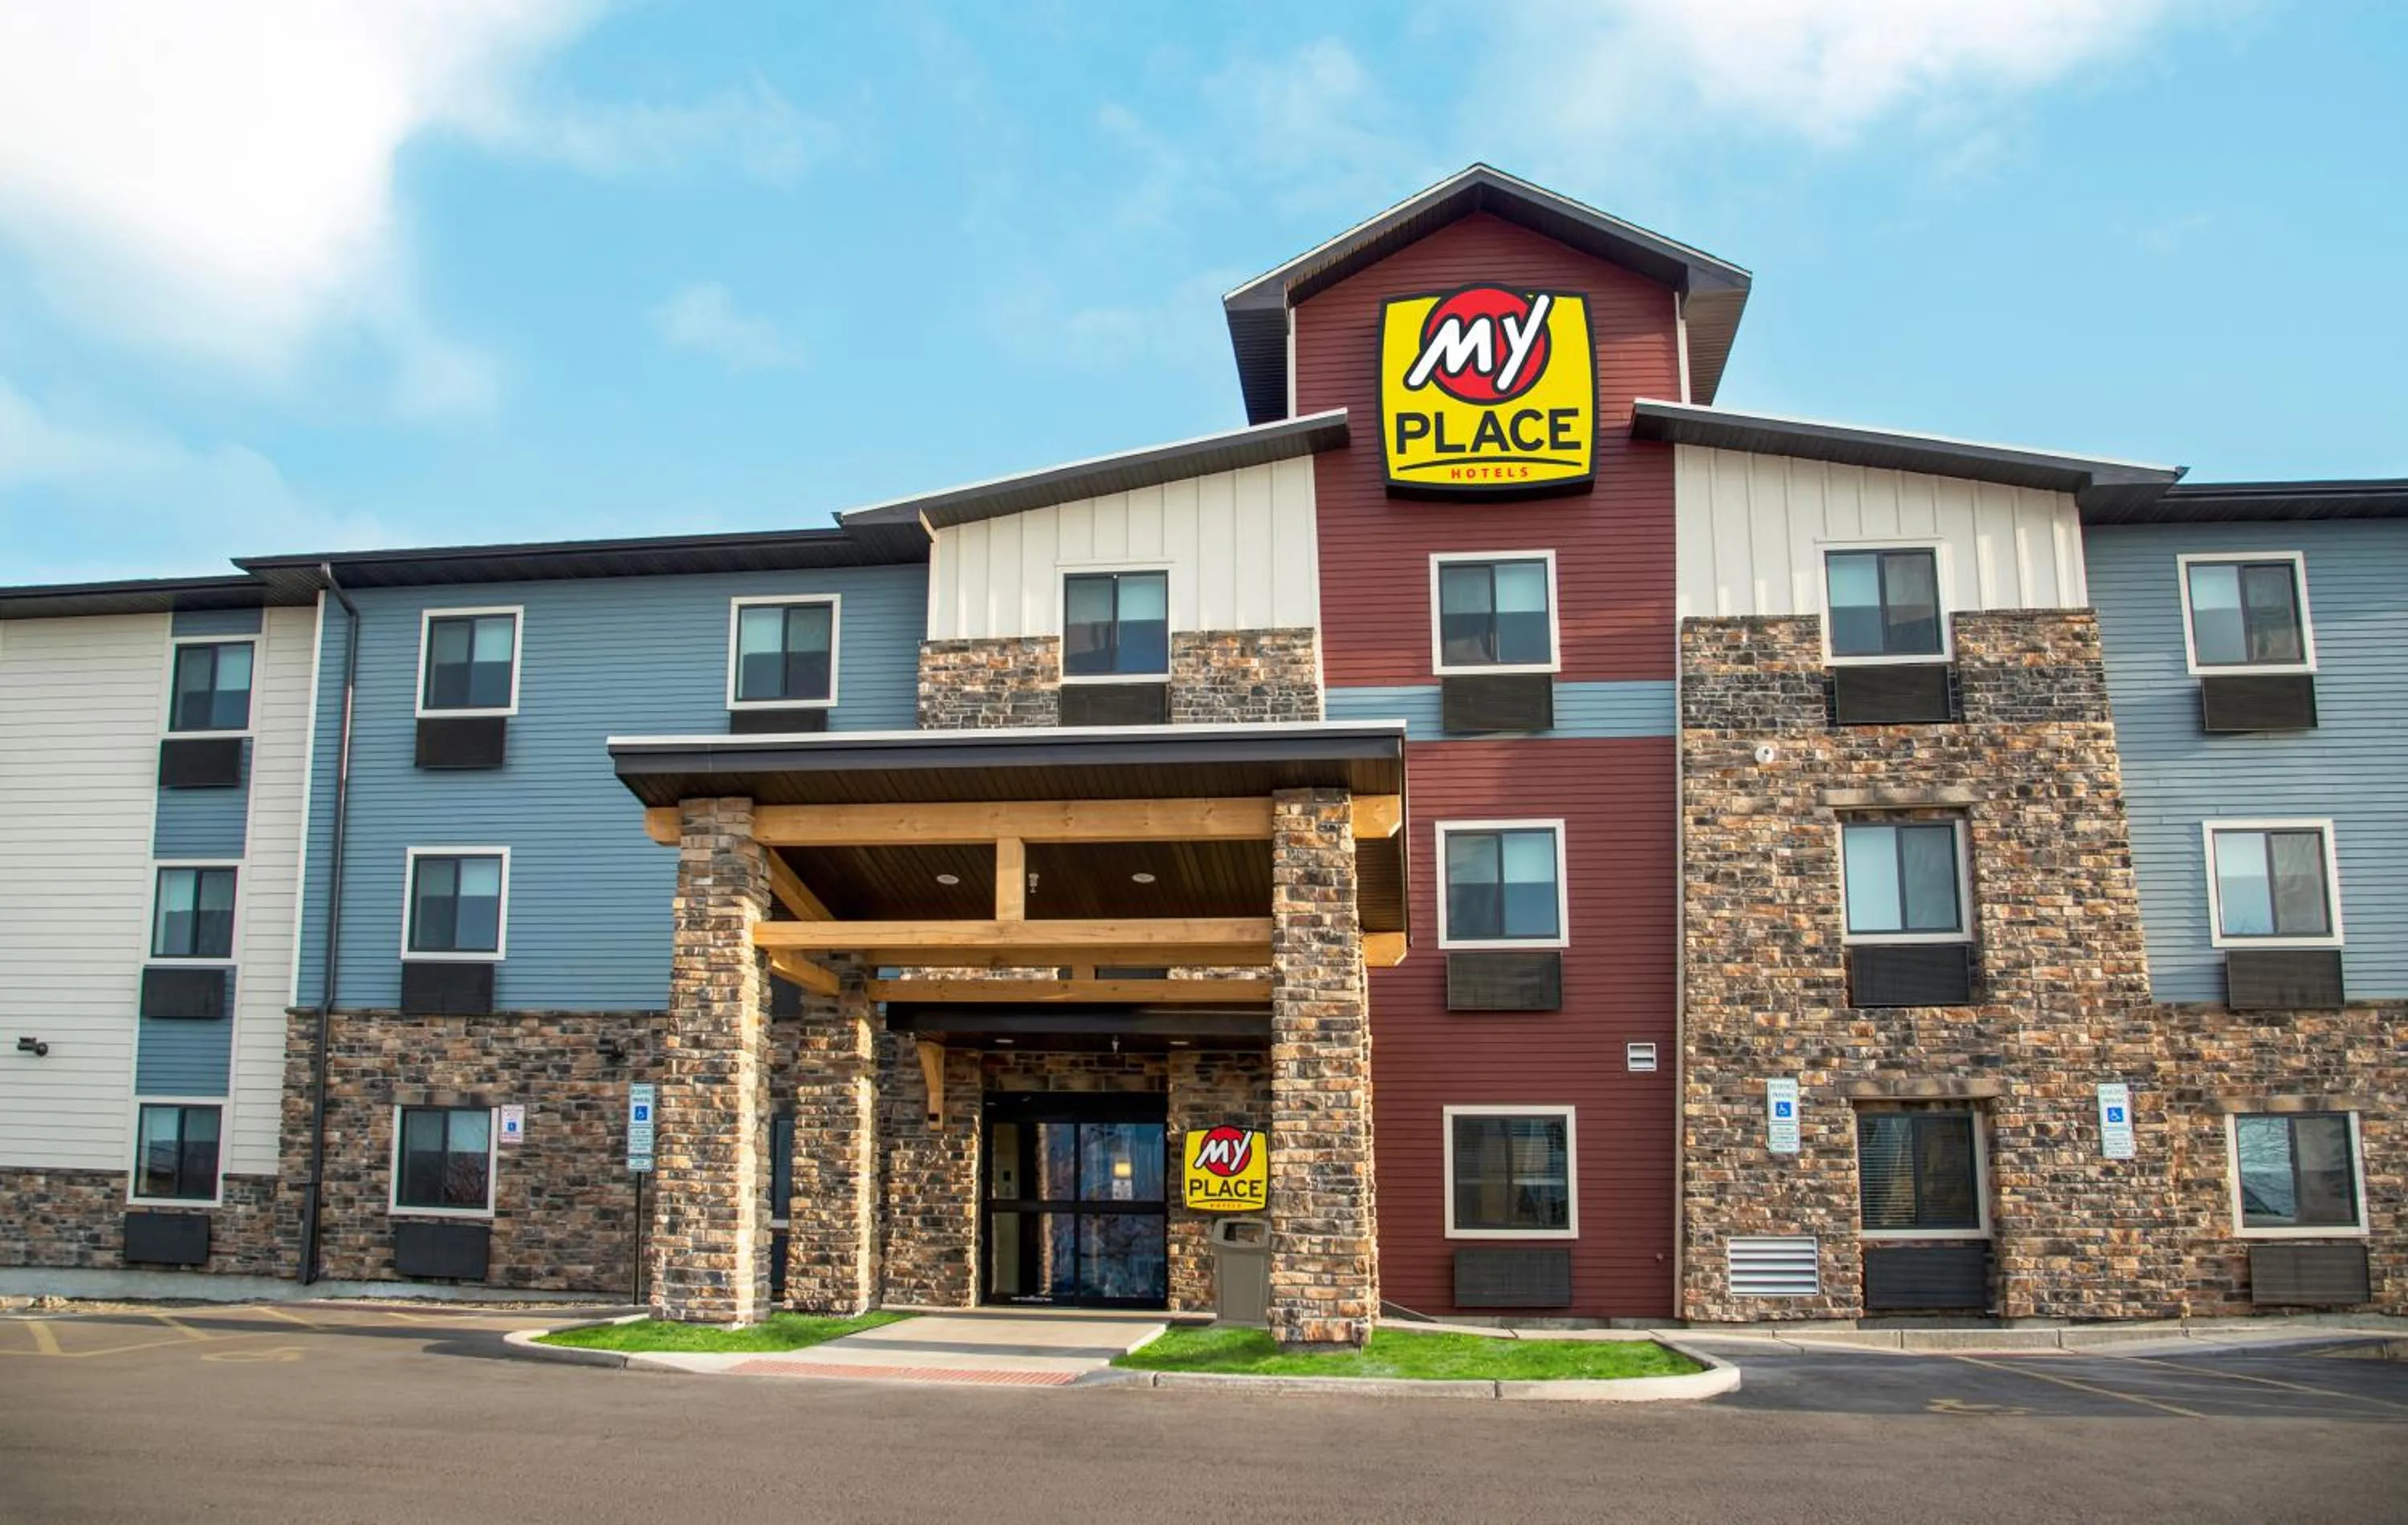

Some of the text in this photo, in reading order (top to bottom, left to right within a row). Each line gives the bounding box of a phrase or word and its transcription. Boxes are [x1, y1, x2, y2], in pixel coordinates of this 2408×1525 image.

[1396, 408, 1582, 455] PLACE
[1450, 466, 1529, 479] HOTELS
[1189, 1179, 1263, 1198] PLACE
